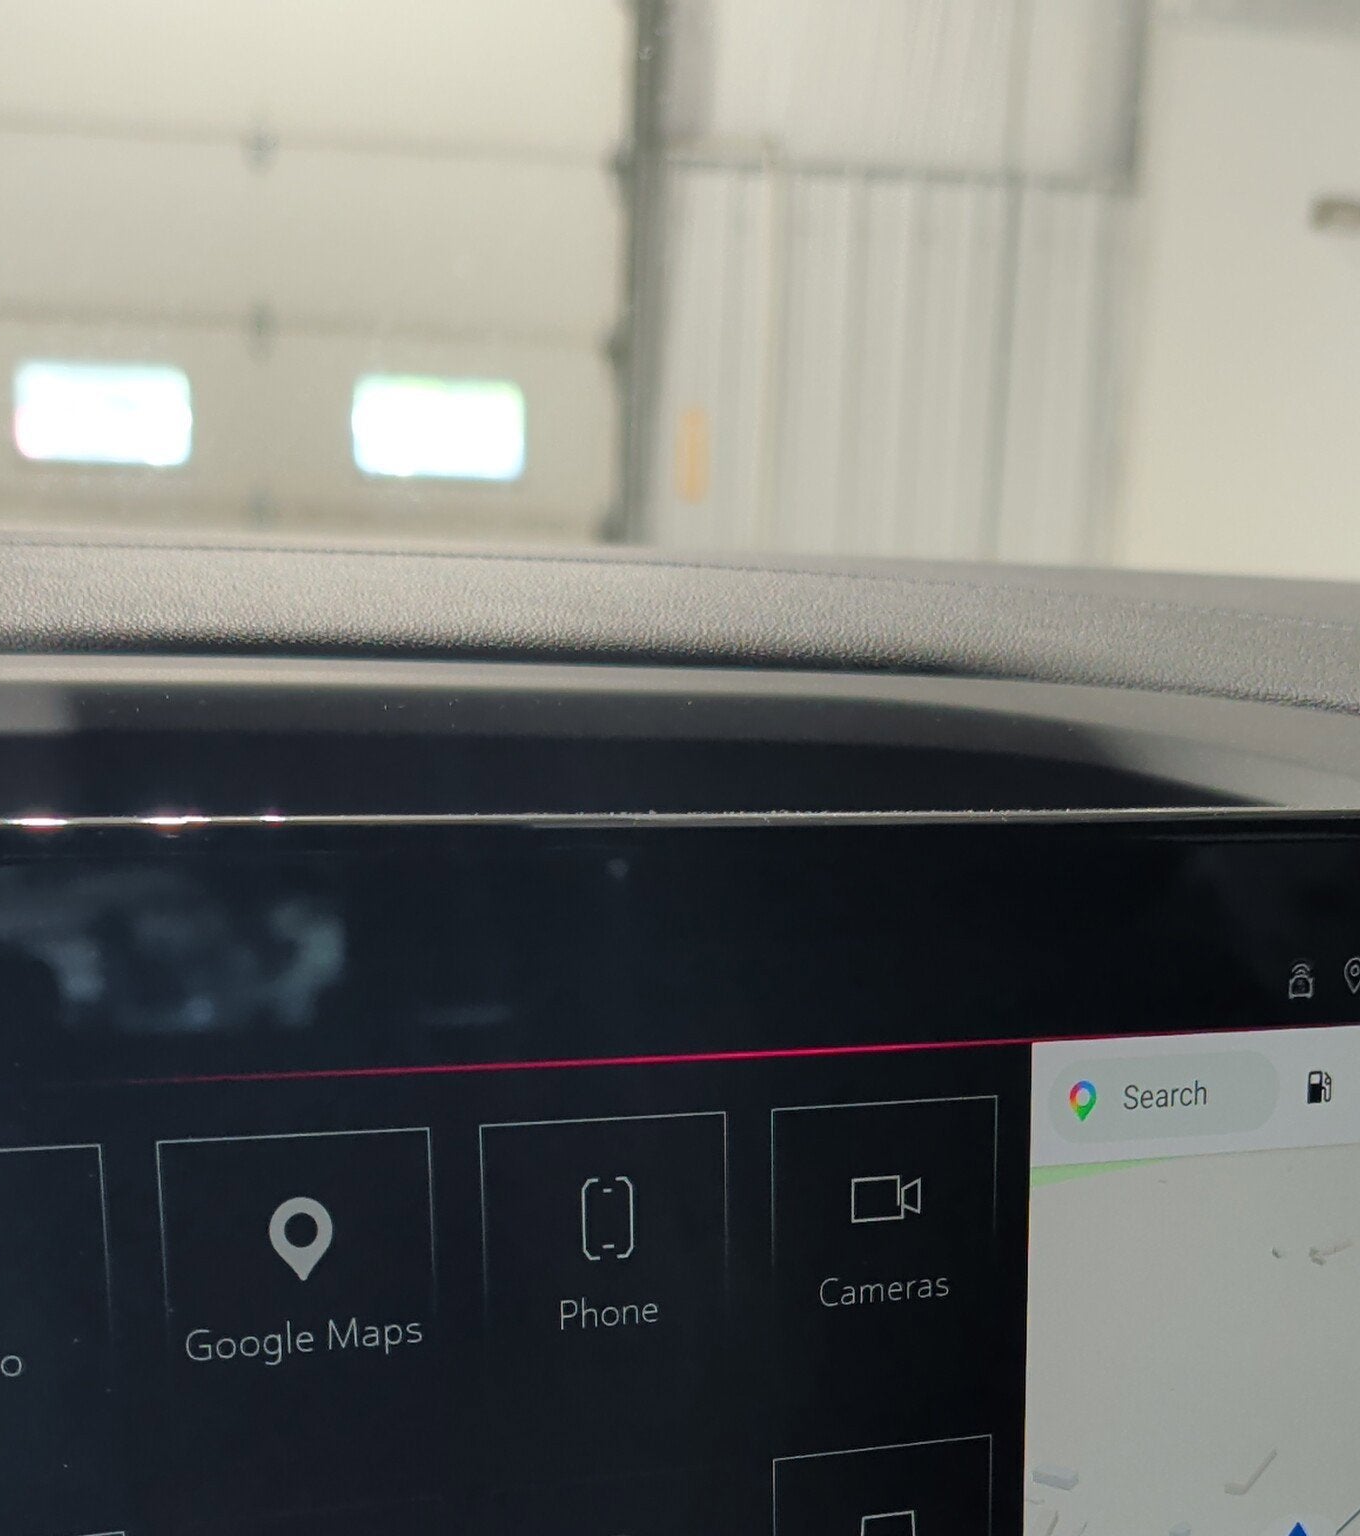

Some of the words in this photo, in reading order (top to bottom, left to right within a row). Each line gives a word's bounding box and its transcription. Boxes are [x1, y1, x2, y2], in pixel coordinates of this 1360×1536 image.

[1124, 1080, 1206, 1109] Search
[820, 1278, 948, 1306] Cameras
[561, 1298, 657, 1330] Phone
[186, 1322, 313, 1365] Google
[329, 1318, 422, 1354] Maps
